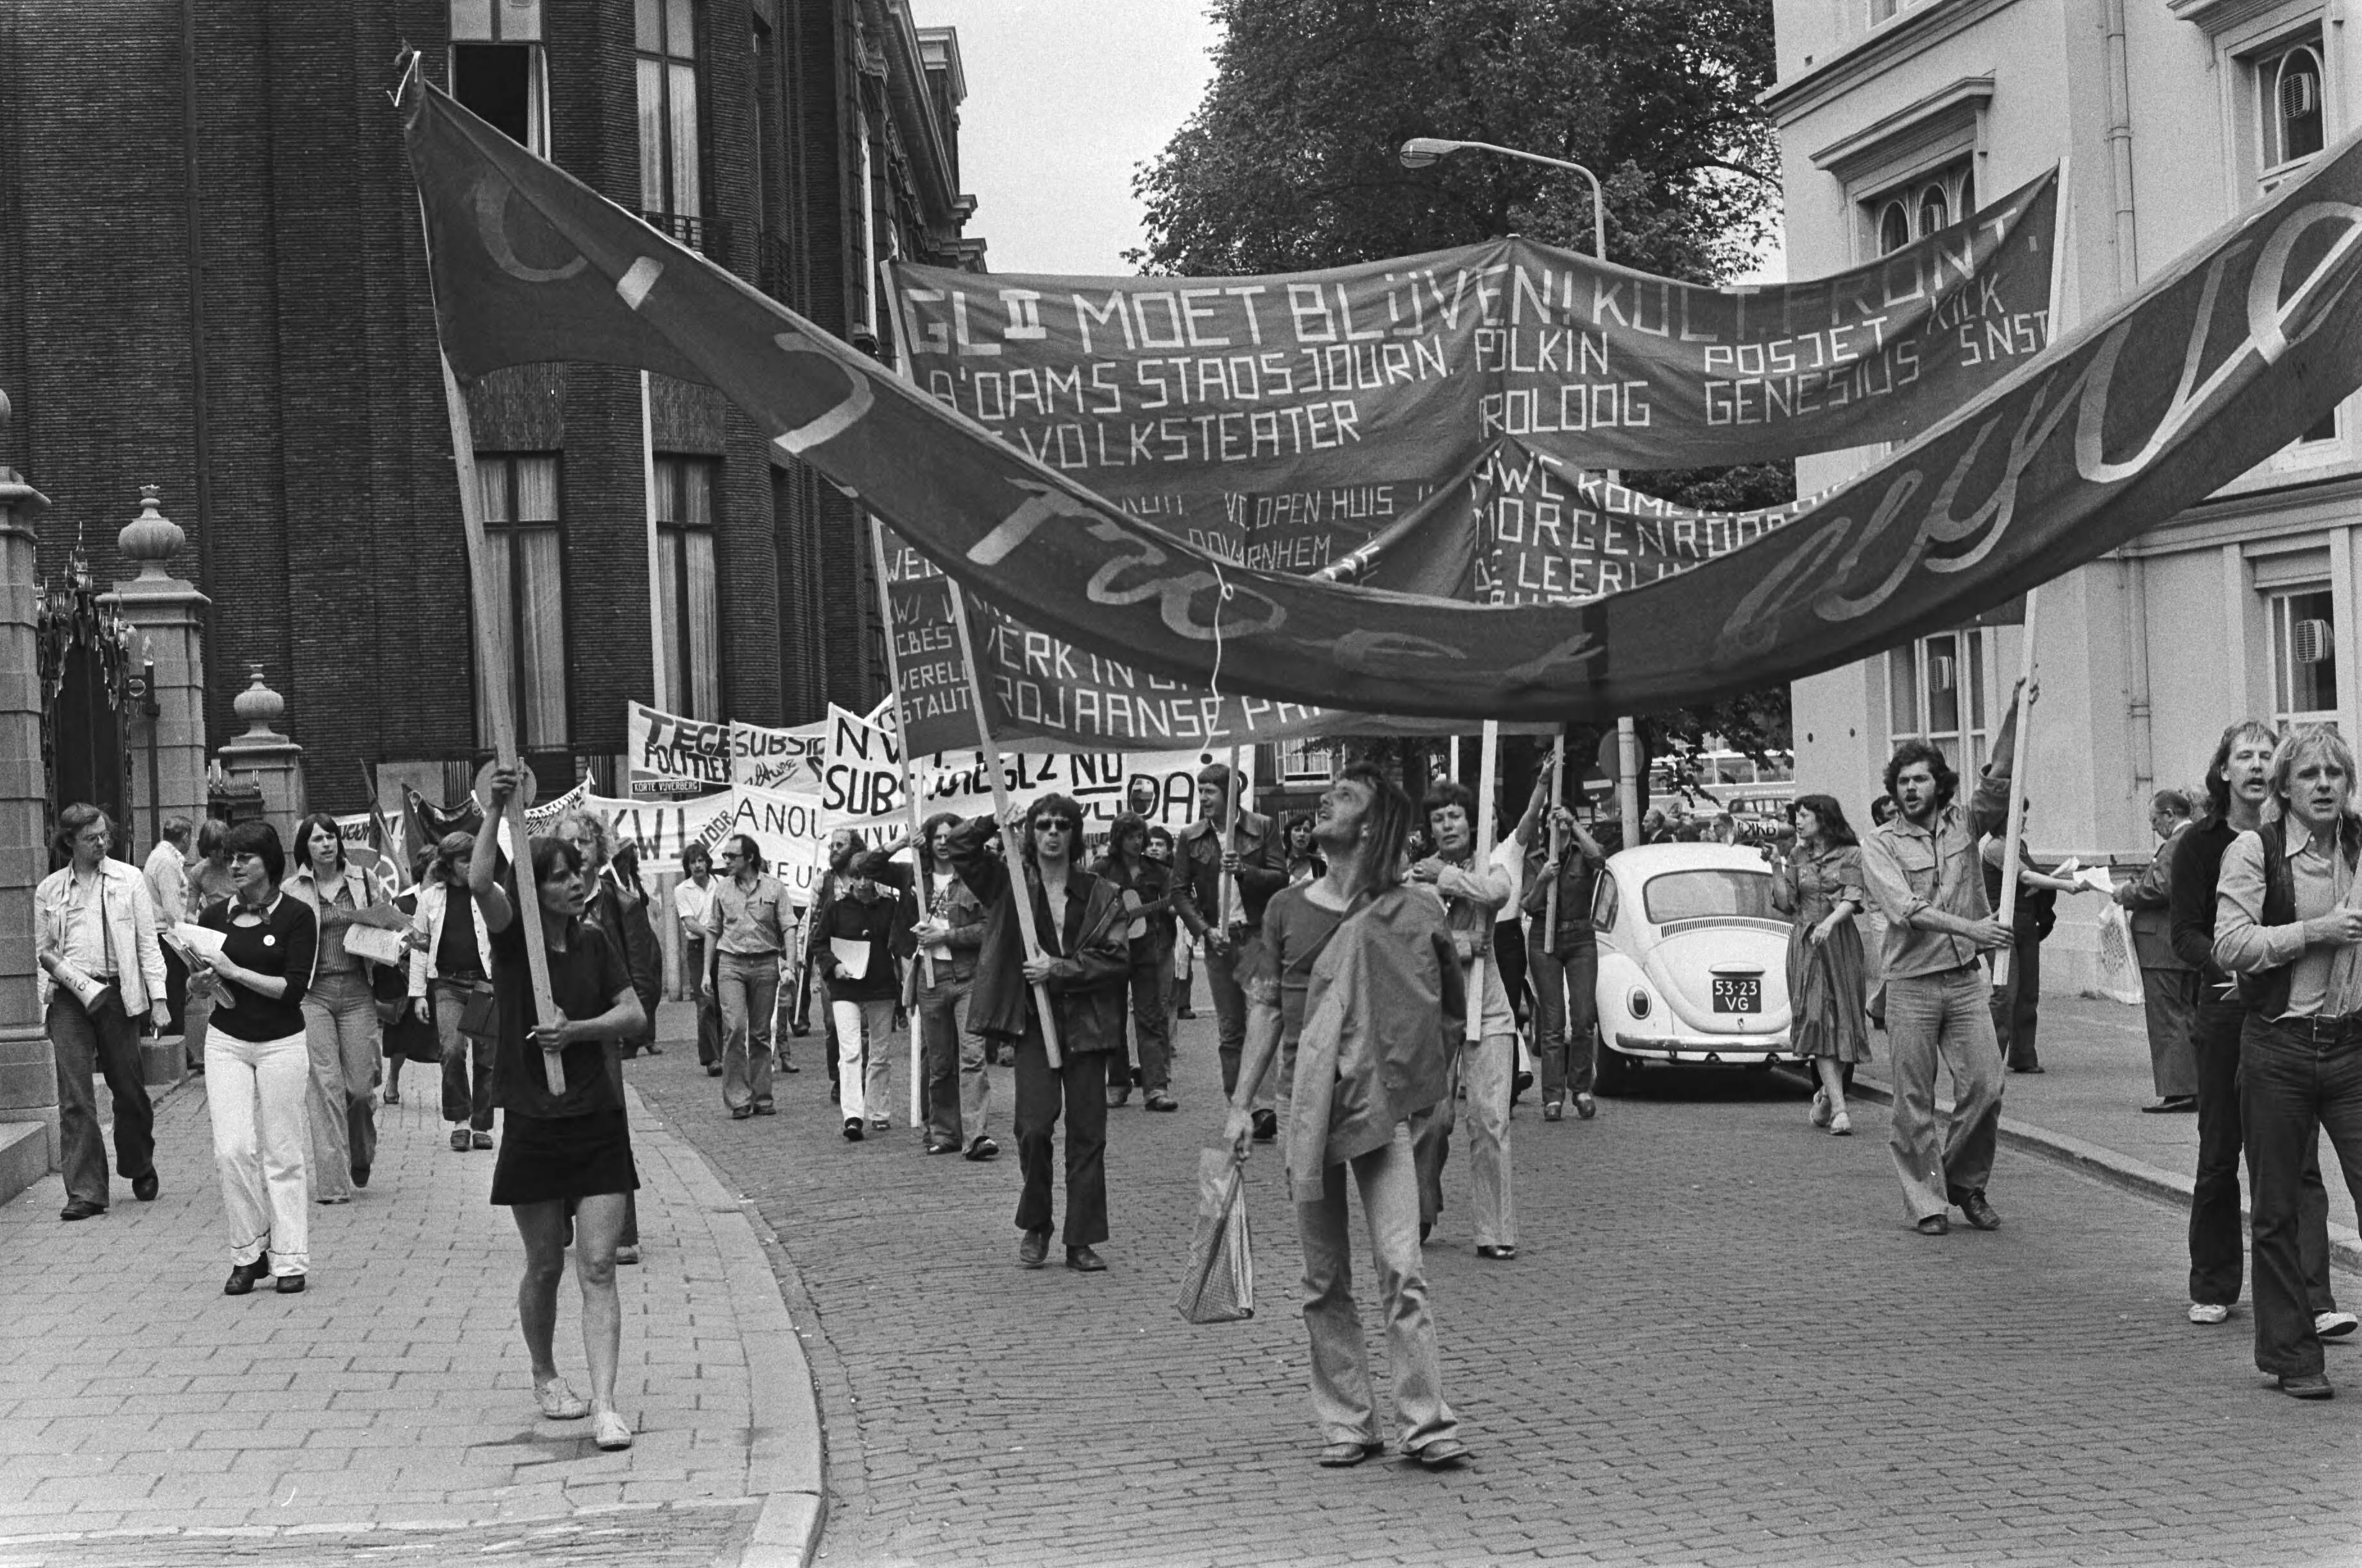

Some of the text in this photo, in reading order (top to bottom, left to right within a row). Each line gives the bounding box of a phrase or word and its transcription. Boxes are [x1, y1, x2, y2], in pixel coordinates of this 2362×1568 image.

[1072, 285, 1266, 353] MOET
[1704, 316, 1888, 375] POSJET
[1019, 339, 1920, 469] VOLKSTEATER ROLOOG GENESIUS
[1255, 490, 1320, 529] OPEN
[1331, 485, 1393, 520] HUIS
[634, 782, 656, 792] KORTE
[1725, 996, 1749, 1011] VG
